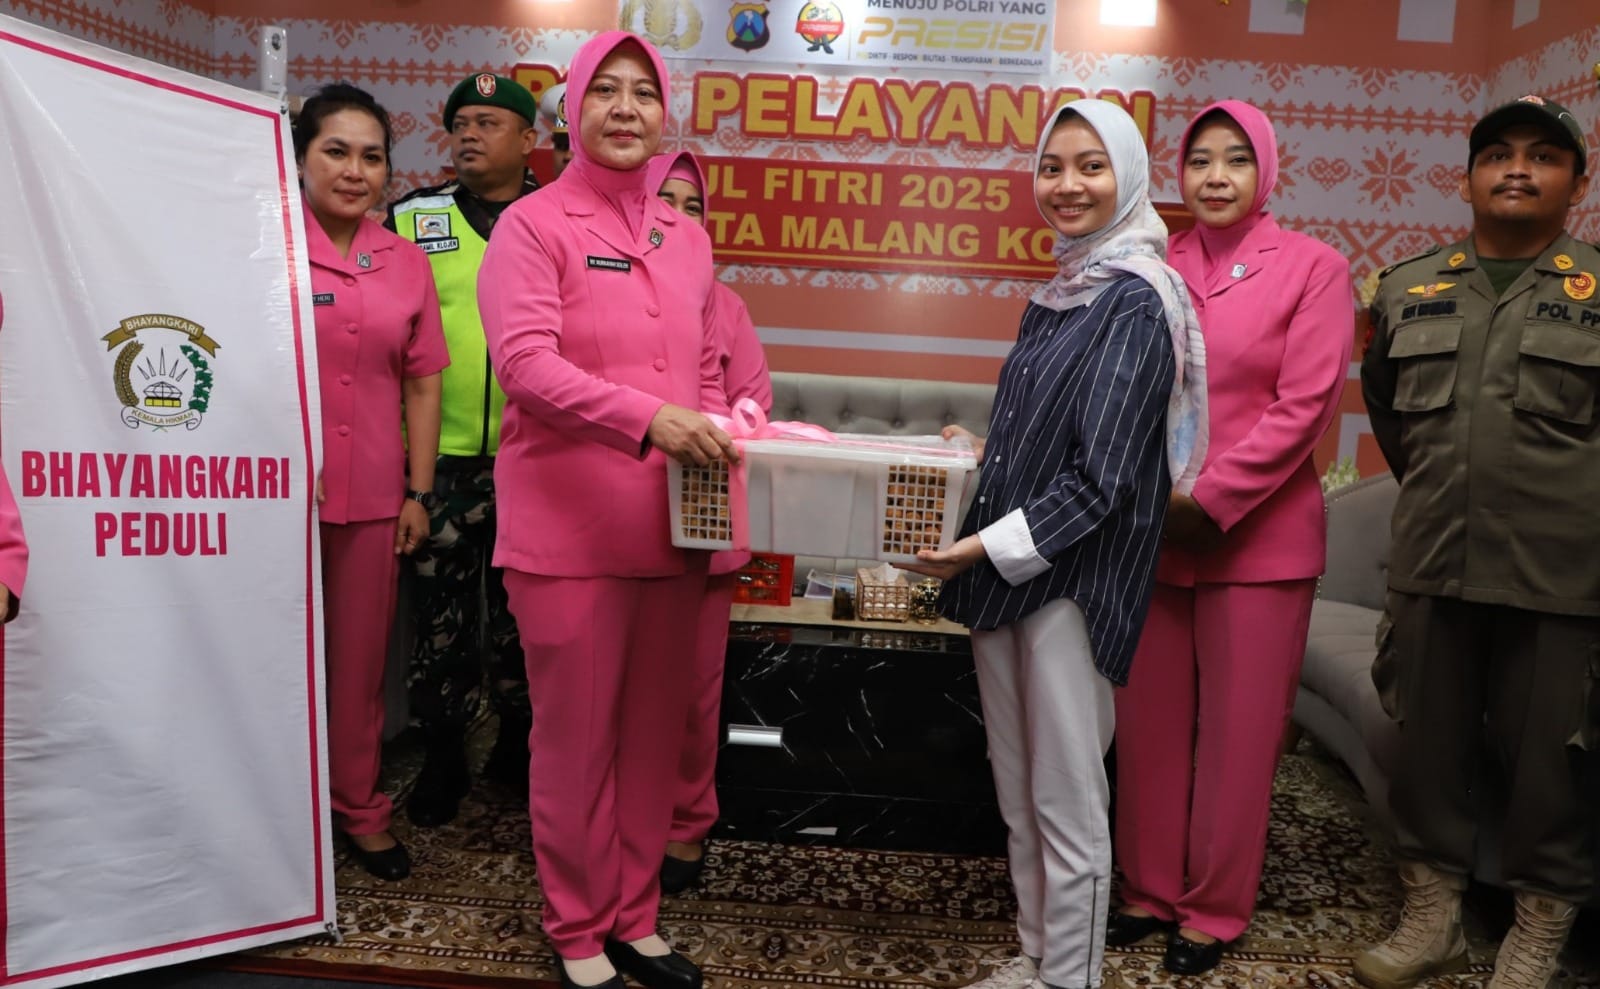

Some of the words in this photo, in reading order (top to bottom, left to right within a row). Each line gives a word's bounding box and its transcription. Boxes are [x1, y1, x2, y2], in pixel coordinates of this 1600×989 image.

[867, 0, 939, 10] MENUJU
[943, 0, 994, 13] POLRI
[999, 1, 1046, 15] YANG
[857, 16, 1048, 52] PRESISI
[696, 76, 1151, 145] PELAYANN
[763, 167, 883, 206] FITRI
[899, 173, 1011, 212] 2025
[780, 215, 980, 258] MALANG
[125, 316, 199, 335] BHAYANGKARI
[1536, 302, 1572, 321] POL
[131, 409, 164, 424] KEMALA
[21, 451, 290, 499] BHAYANGKARI
[95, 512, 228, 557] PEDULI
